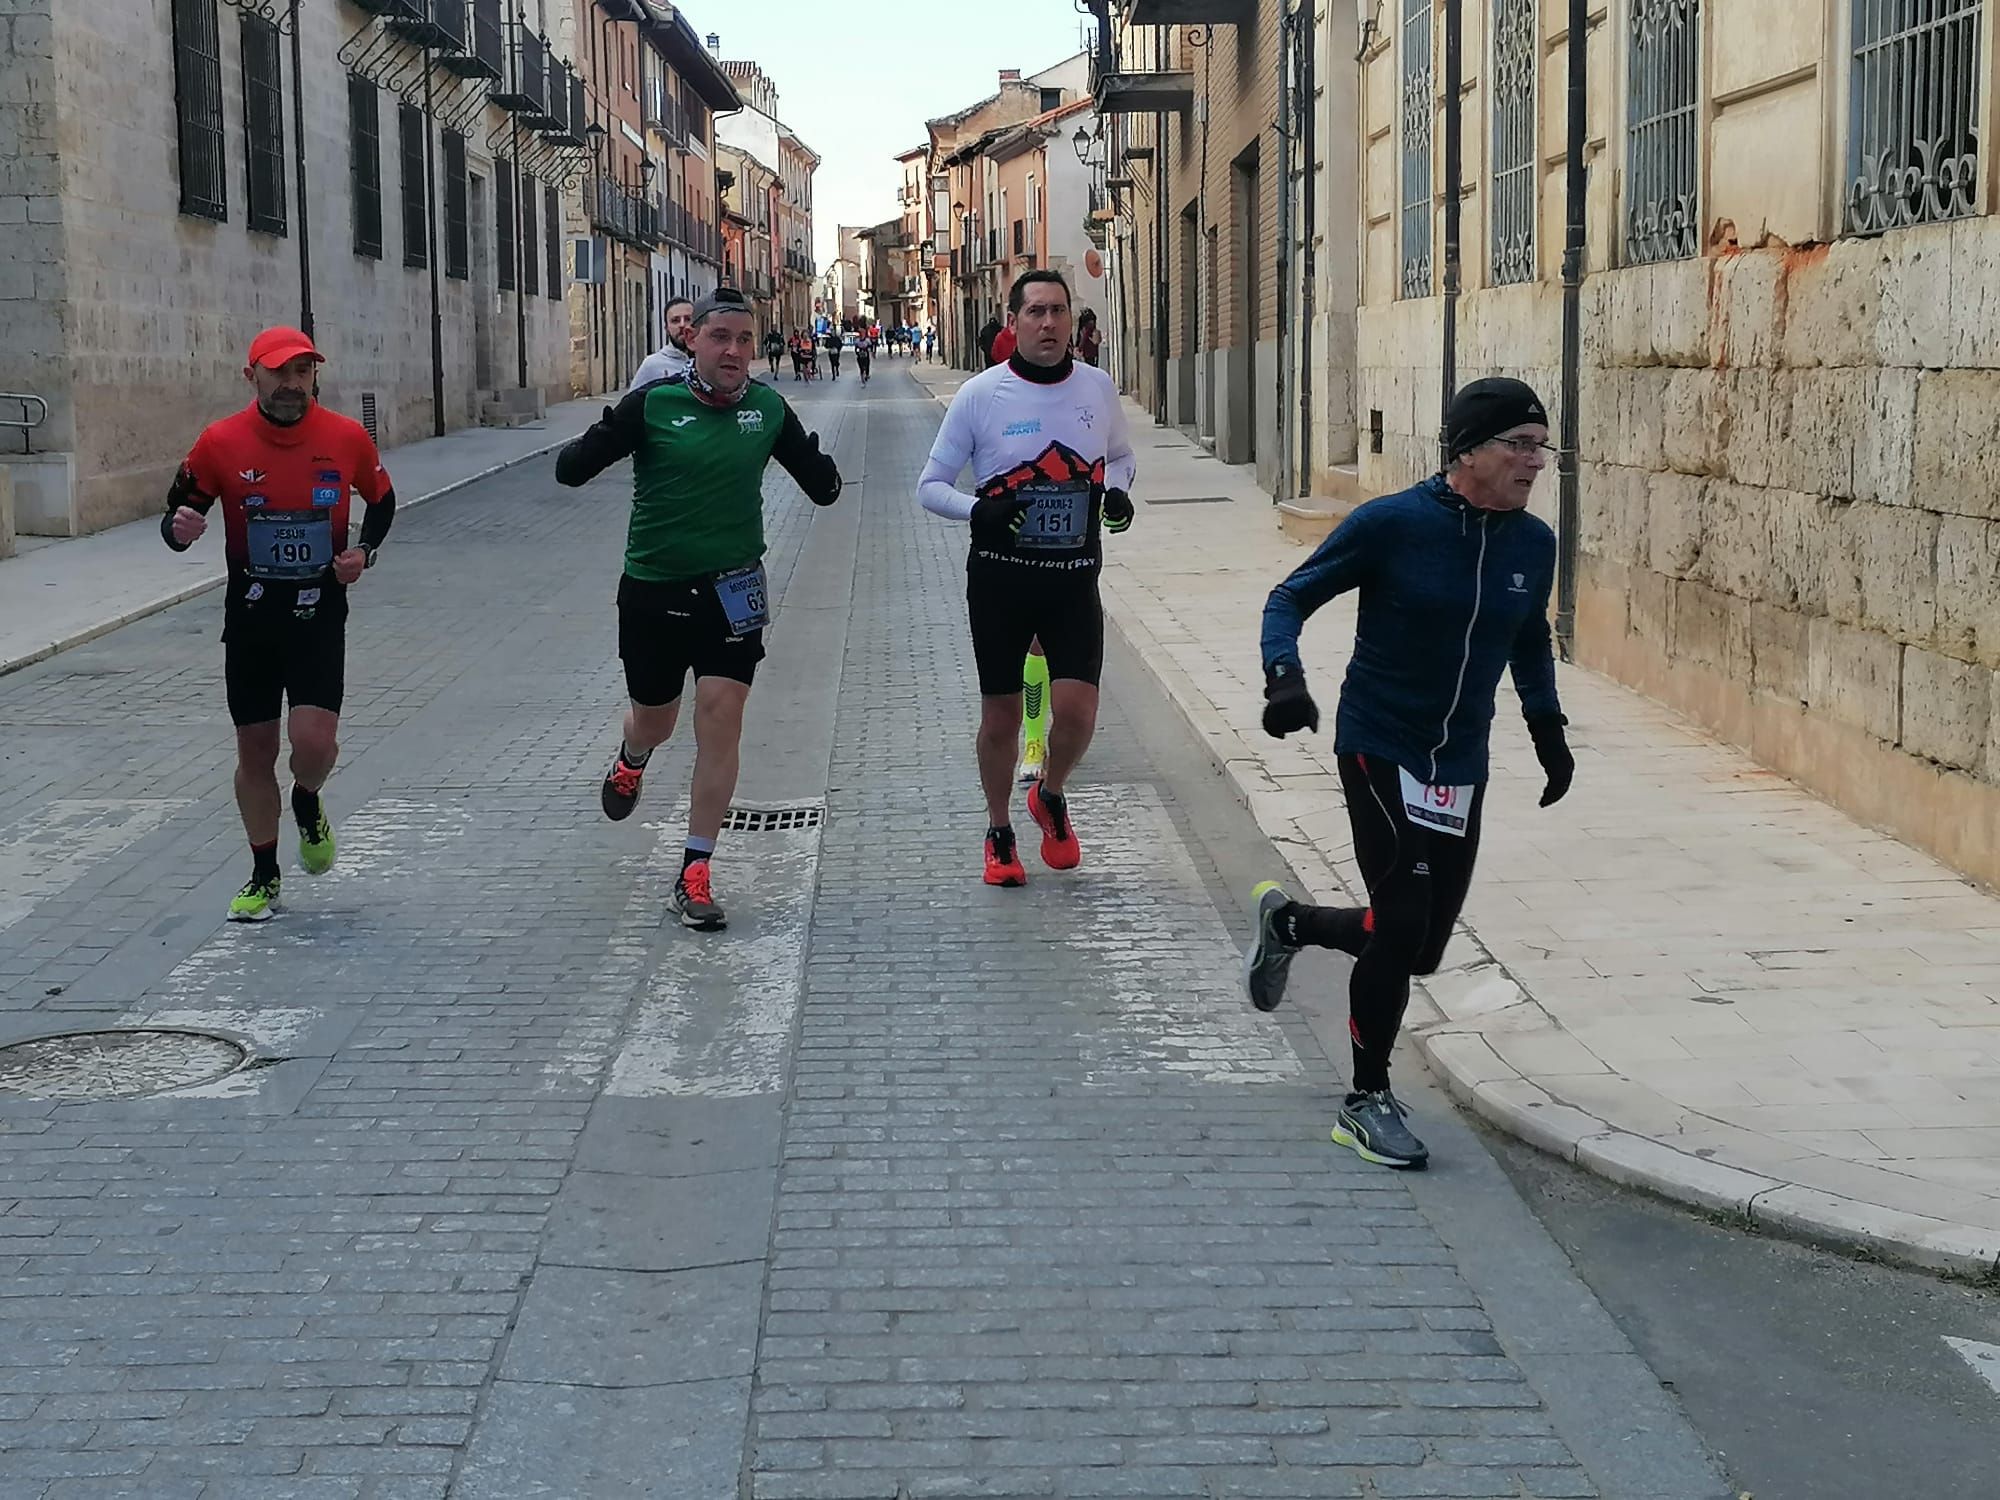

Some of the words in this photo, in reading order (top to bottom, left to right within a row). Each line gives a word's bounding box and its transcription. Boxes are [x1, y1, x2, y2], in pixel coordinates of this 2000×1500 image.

[1036, 513, 1072, 533] 151
[270, 543, 312, 563] 190
[746, 589, 766, 612] 63
